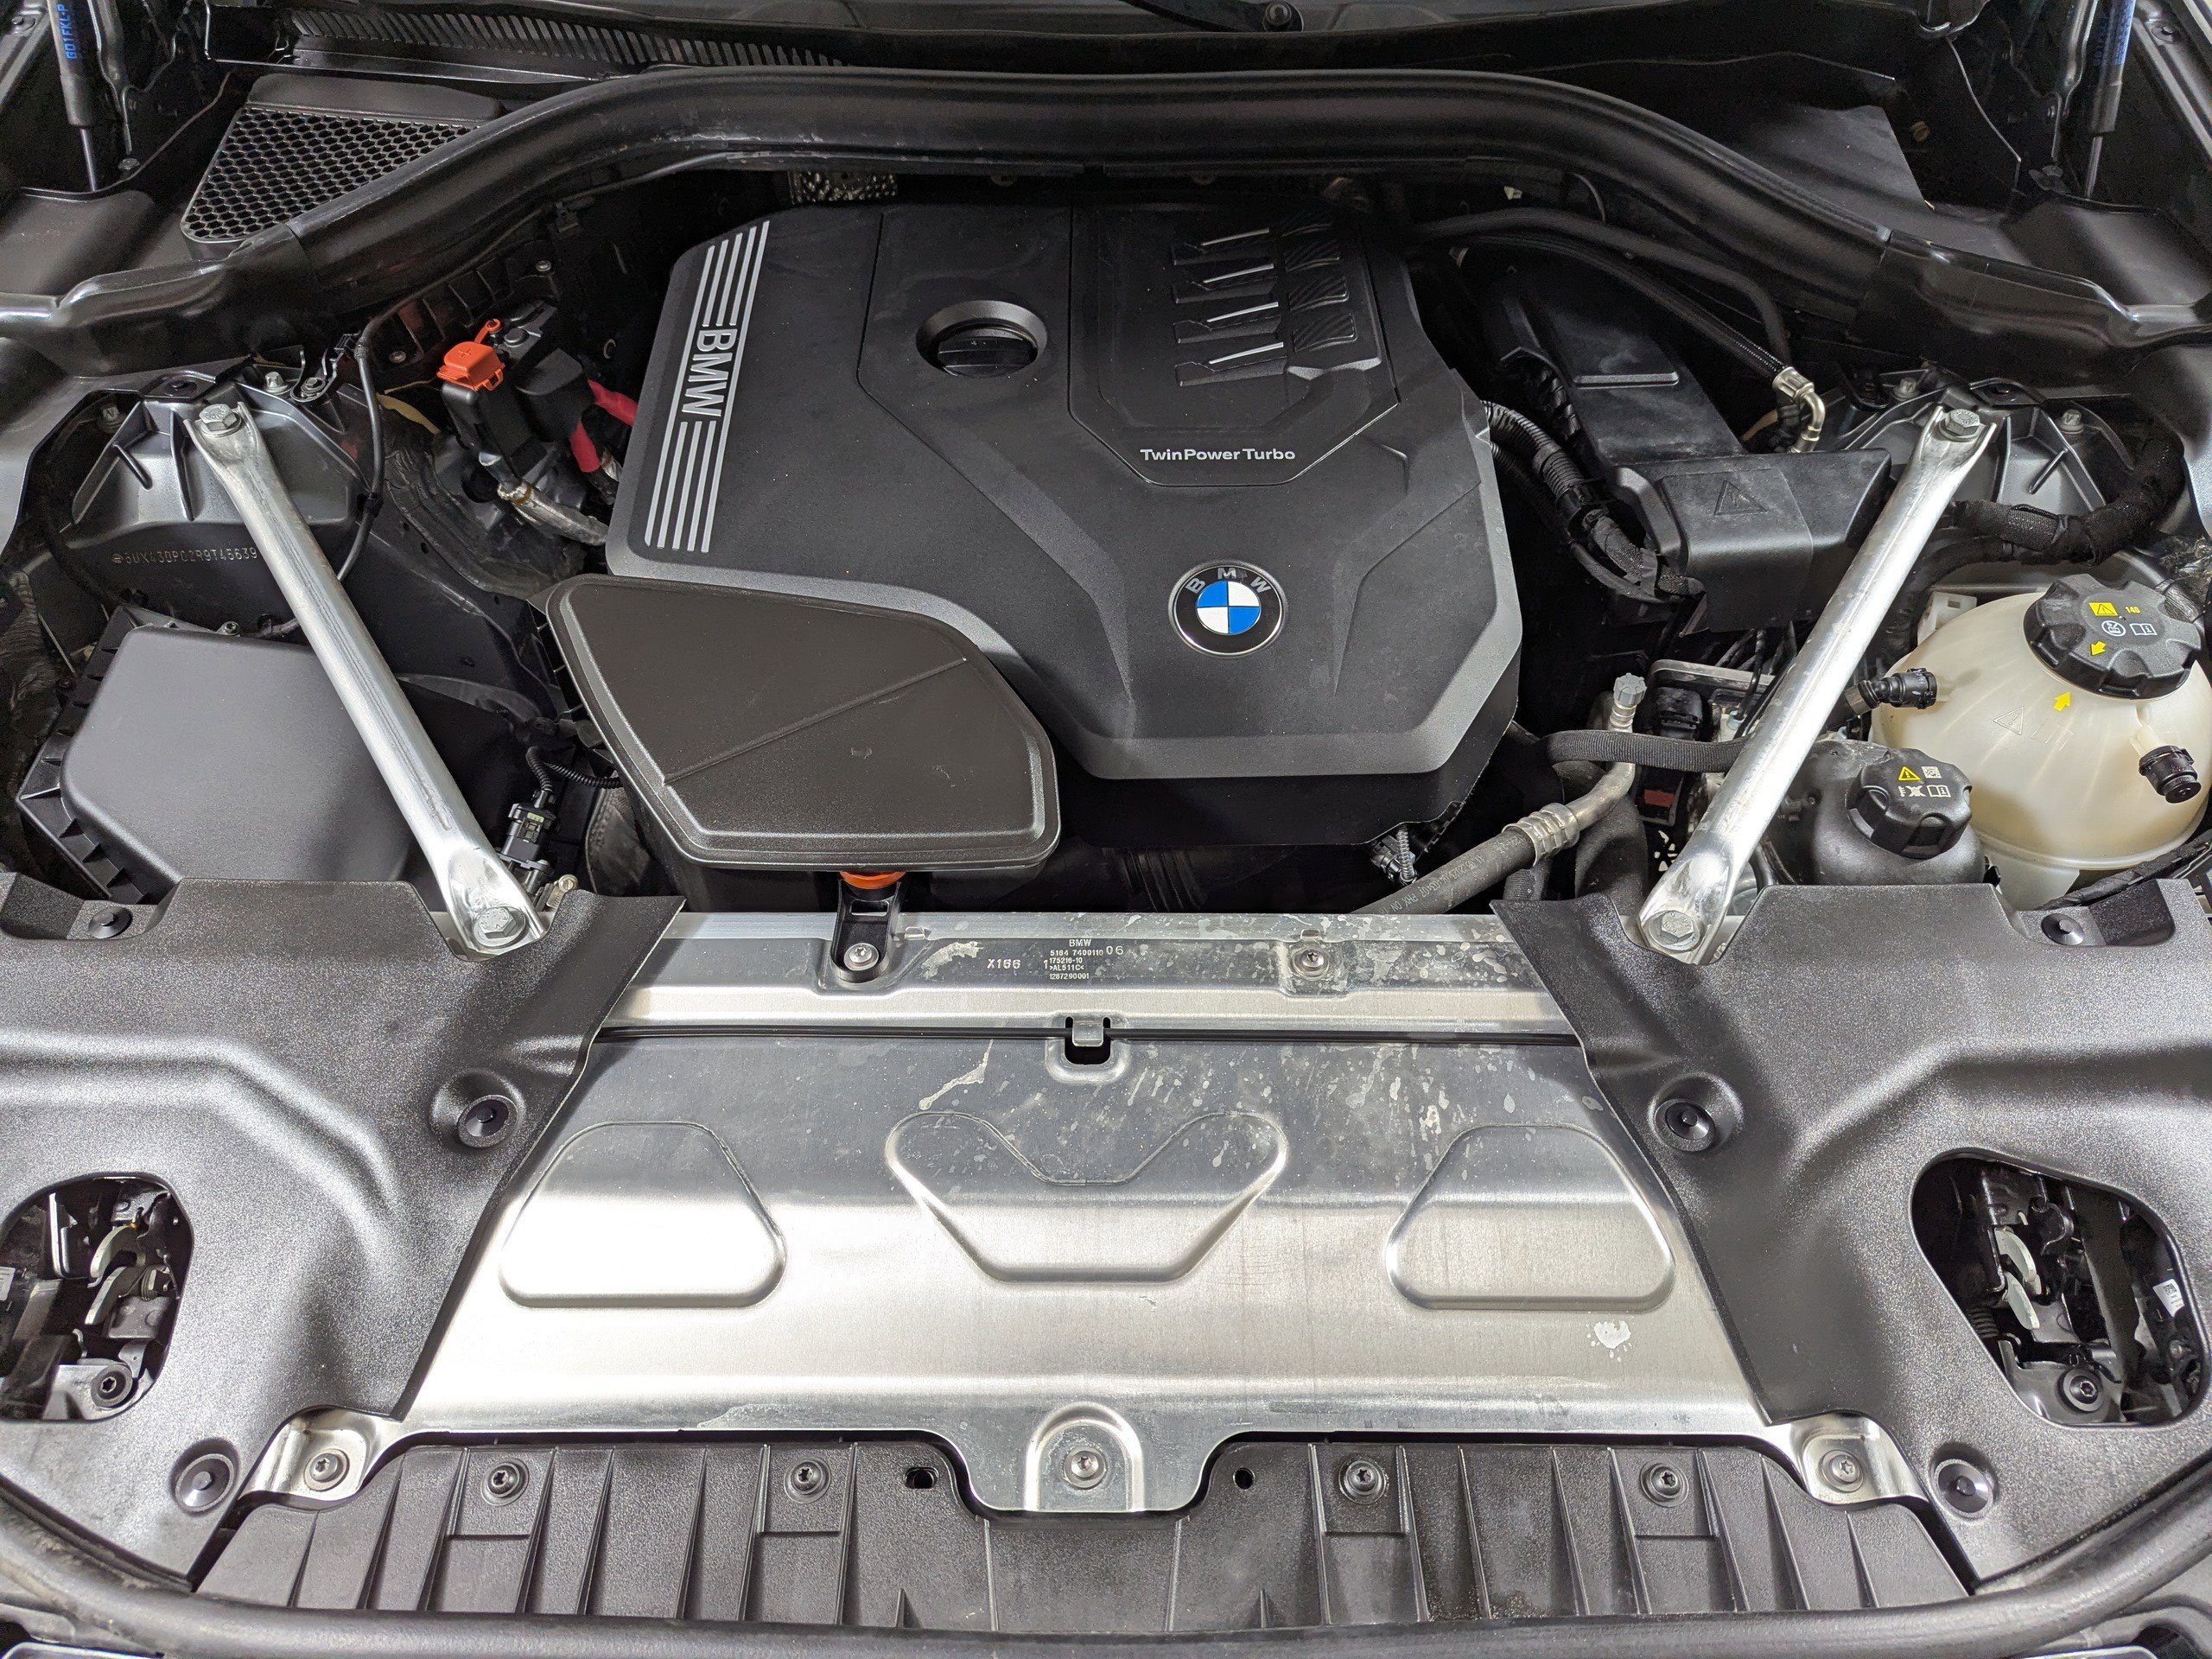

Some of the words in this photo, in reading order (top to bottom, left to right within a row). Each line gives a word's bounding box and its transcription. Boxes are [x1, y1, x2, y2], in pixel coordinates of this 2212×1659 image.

[681, 328, 738, 417] BMW
[1140, 448, 1241, 461] TwinPower
[1242, 448, 1296, 461] Turbo
[1185, 567, 1272, 594] BMW
[1106, 945, 1124, 956] 06
[987, 958, 1021, 969] X166
